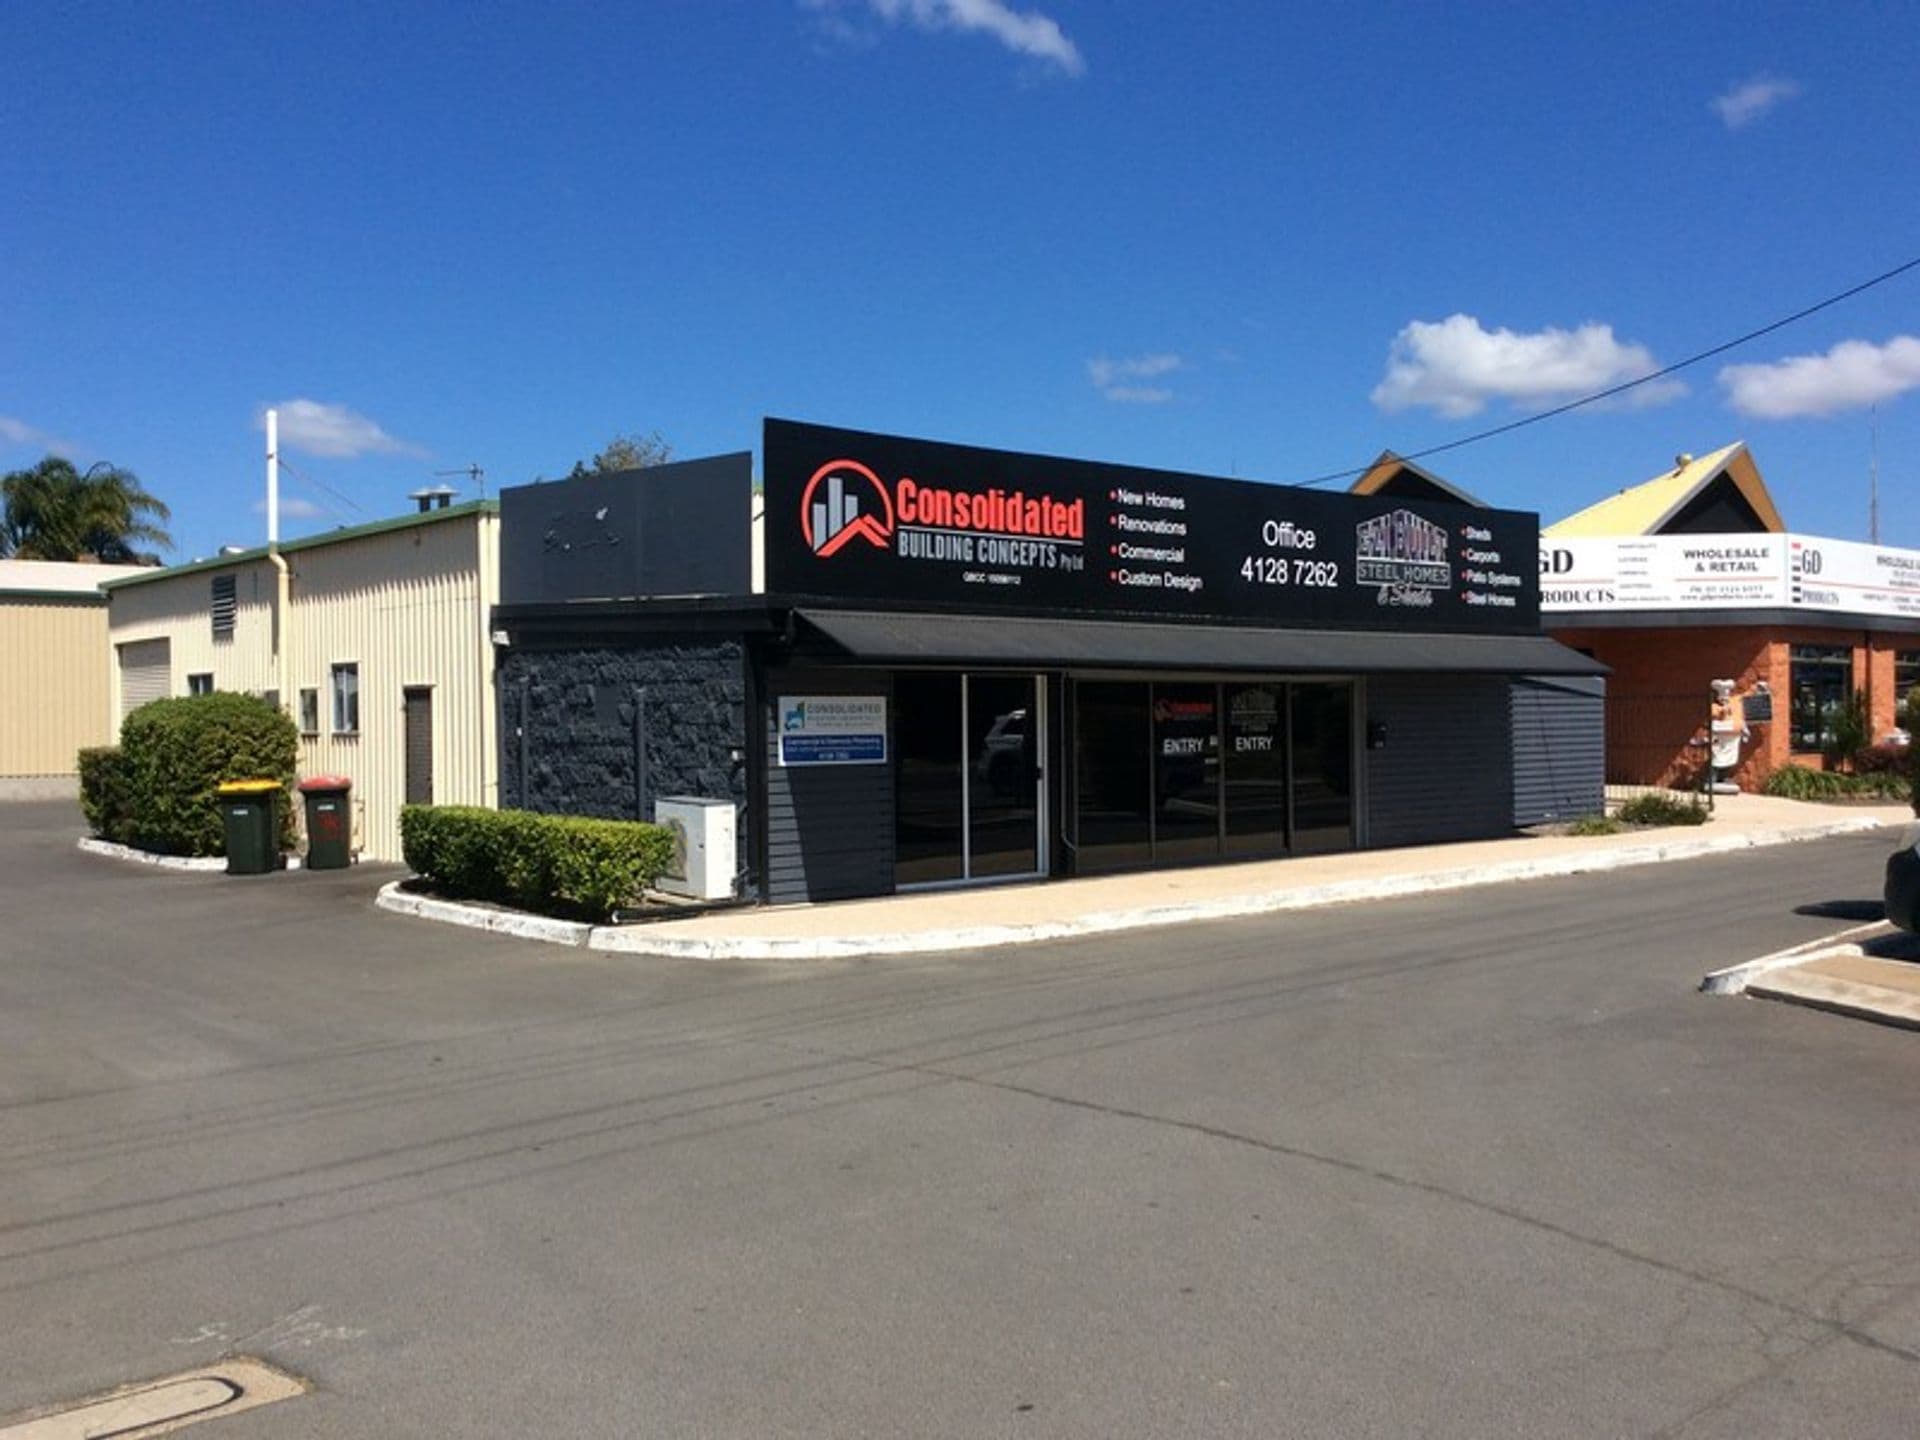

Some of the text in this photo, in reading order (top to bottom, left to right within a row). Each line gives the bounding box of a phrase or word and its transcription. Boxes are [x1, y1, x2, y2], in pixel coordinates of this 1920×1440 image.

[897, 478, 1083, 538] Consolidated
[1118, 489, 1185, 510] New Homes
[1118, 514, 1187, 536] Renovations
[1262, 520, 1317, 549] Office
[898, 532, 973, 562] BUILDING
[977, 538, 1057, 568] CONCEPTS
[1118, 543, 1185, 563] Commercial
[1682, 547, 1770, 560] WHOLESALE
[1241, 556, 1339, 587] 4128 7262
[1359, 562, 1449, 583] STEEL HOMES
[1694, 561, 1759, 573] & RETAIL
[1802, 549, 1822, 575] GD
[1118, 569, 1203, 592] Custom Design
[1538, 589, 1615, 603] RODUCTS
[1164, 738, 1204, 755] ENTRY
[1236, 736, 1273, 752] ENTRY
